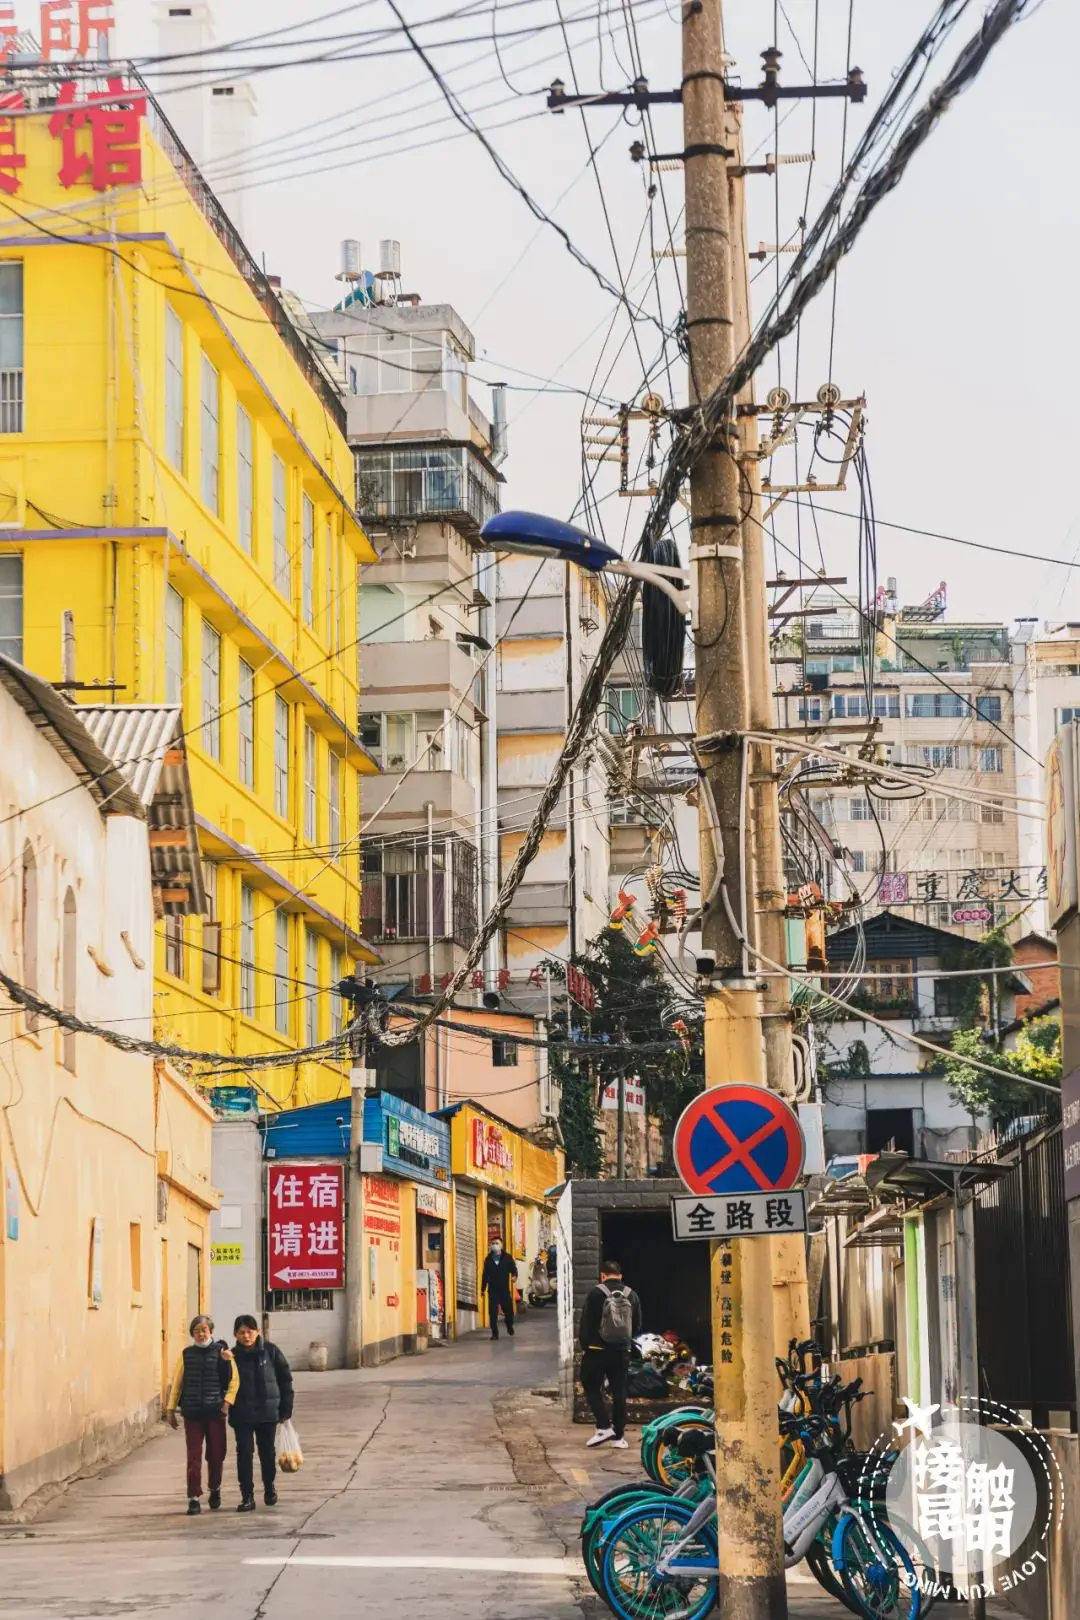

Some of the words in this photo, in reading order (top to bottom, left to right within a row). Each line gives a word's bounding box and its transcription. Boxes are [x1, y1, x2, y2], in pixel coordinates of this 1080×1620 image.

[272, 1172, 339, 1209] 住宿
[686, 1197, 795, 1233] 全路段
[271, 1221, 339, 1257] 请进
